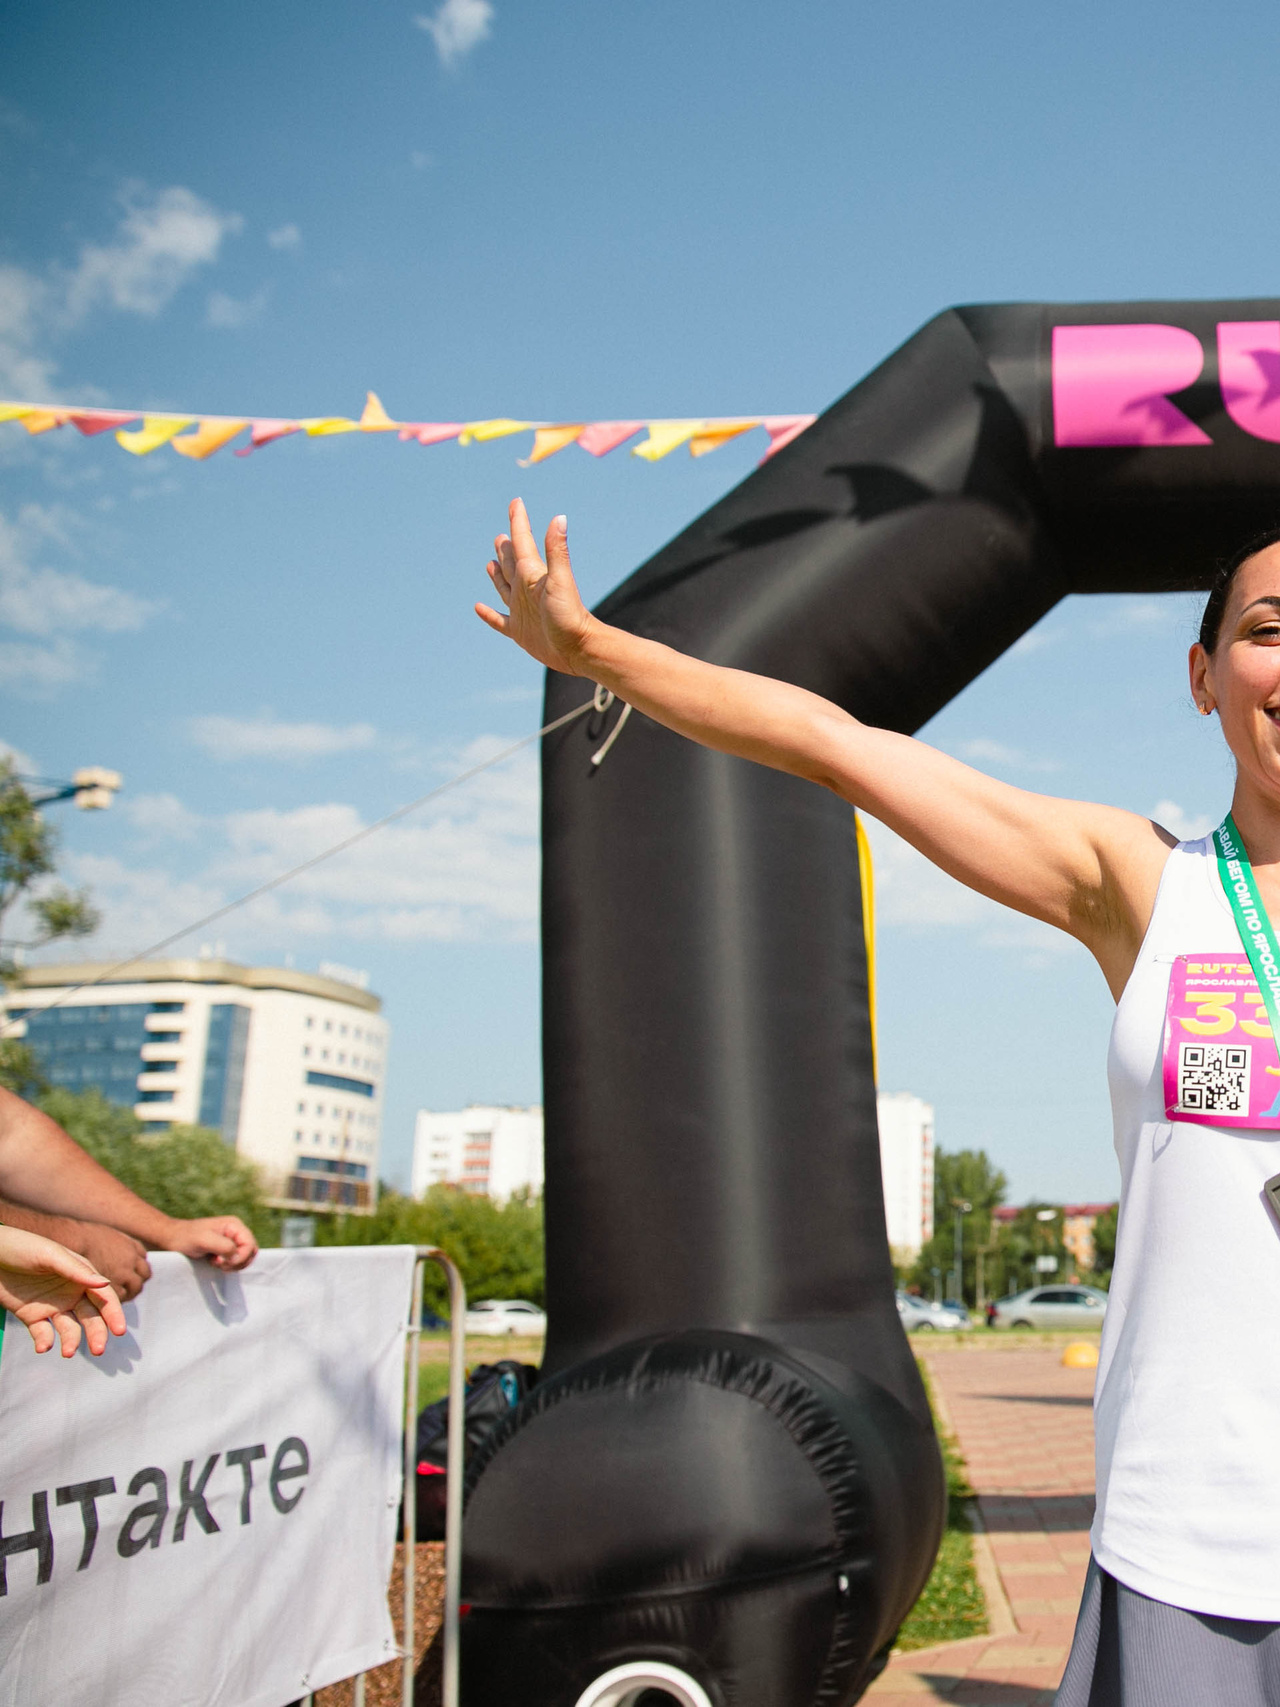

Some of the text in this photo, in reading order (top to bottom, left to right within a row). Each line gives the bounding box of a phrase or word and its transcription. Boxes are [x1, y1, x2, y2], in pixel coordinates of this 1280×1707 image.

[1227, 859, 1254, 907] БЕГОМ
[1243, 908, 1262, 932] ПО
[1186, 963, 1254, 974] RUTS
